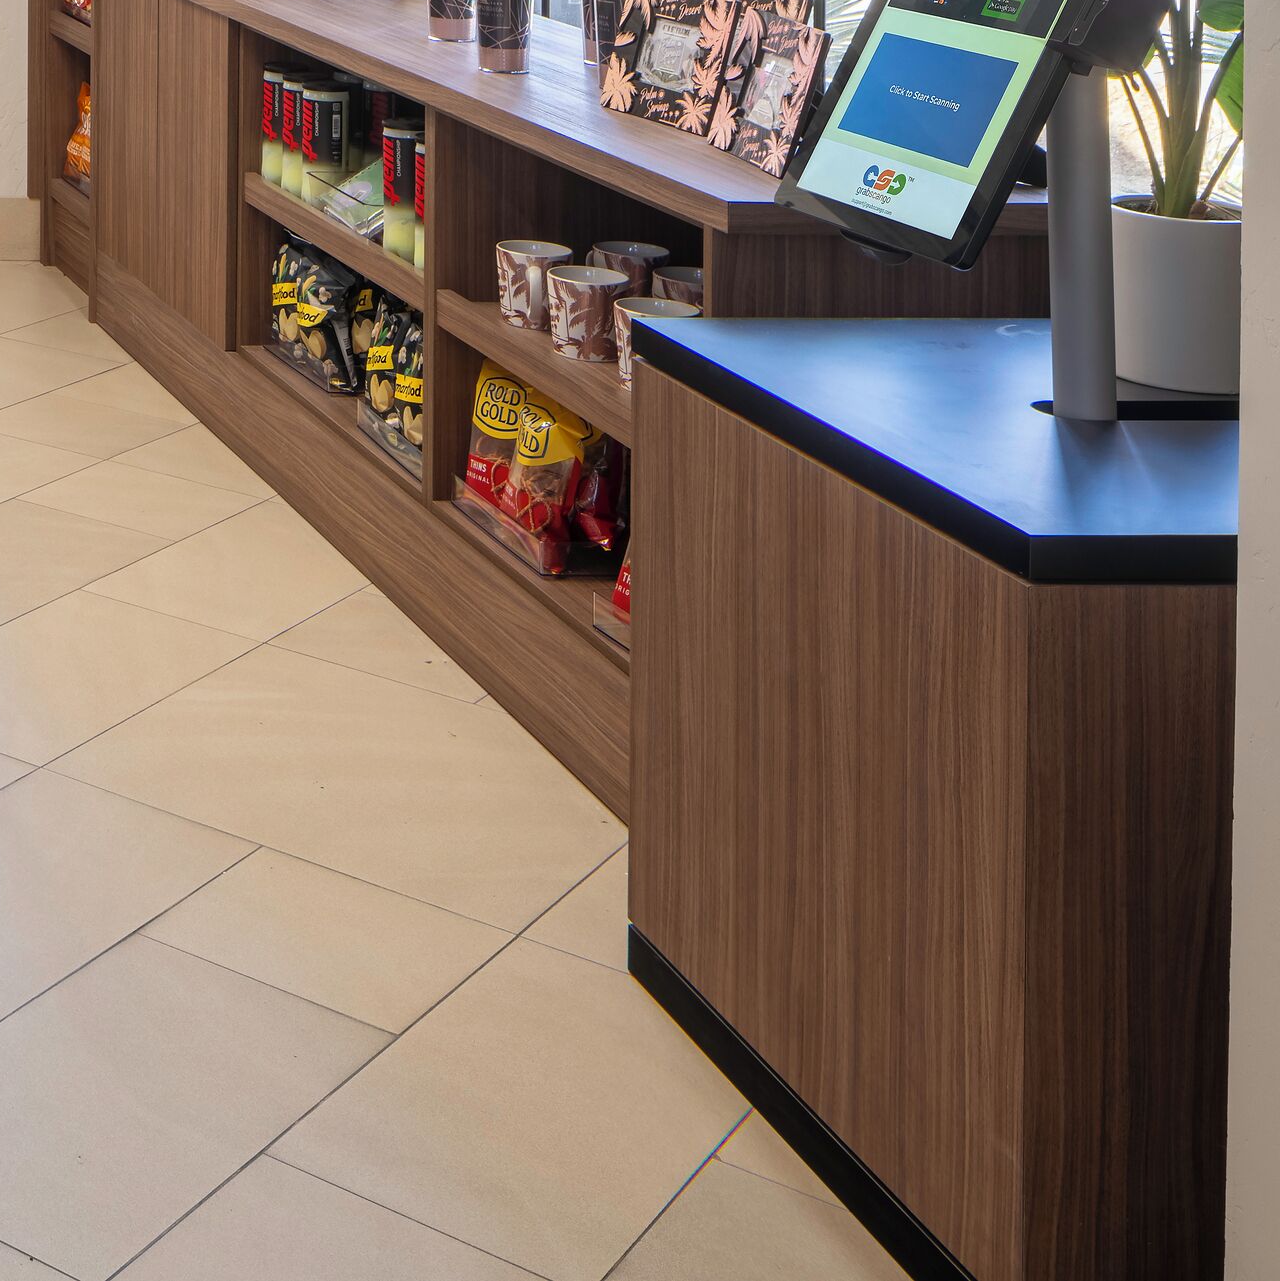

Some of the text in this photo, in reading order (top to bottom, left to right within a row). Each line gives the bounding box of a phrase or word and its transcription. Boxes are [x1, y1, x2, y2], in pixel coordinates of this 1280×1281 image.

[678, 3, 703, 21] Desert
[994, 4, 1008, 12] Google
[640, 86, 657, 104] Palm
[890, 85, 905, 96] Click
[913, 91, 929, 103] Start
[930, 95, 961, 112] Scanning
[262, 83, 279, 143] penn
[645, 100, 670, 118] Springs
[282, 90, 299, 152] penn
[302, 99, 318, 164] penn
[383, 136, 401, 207] penn
[856, 186, 891, 205] grabscango
[486, 384, 520, 406] ROLD
[481, 402, 519, 426] GOLD
[470, 459, 486, 473] THINS
